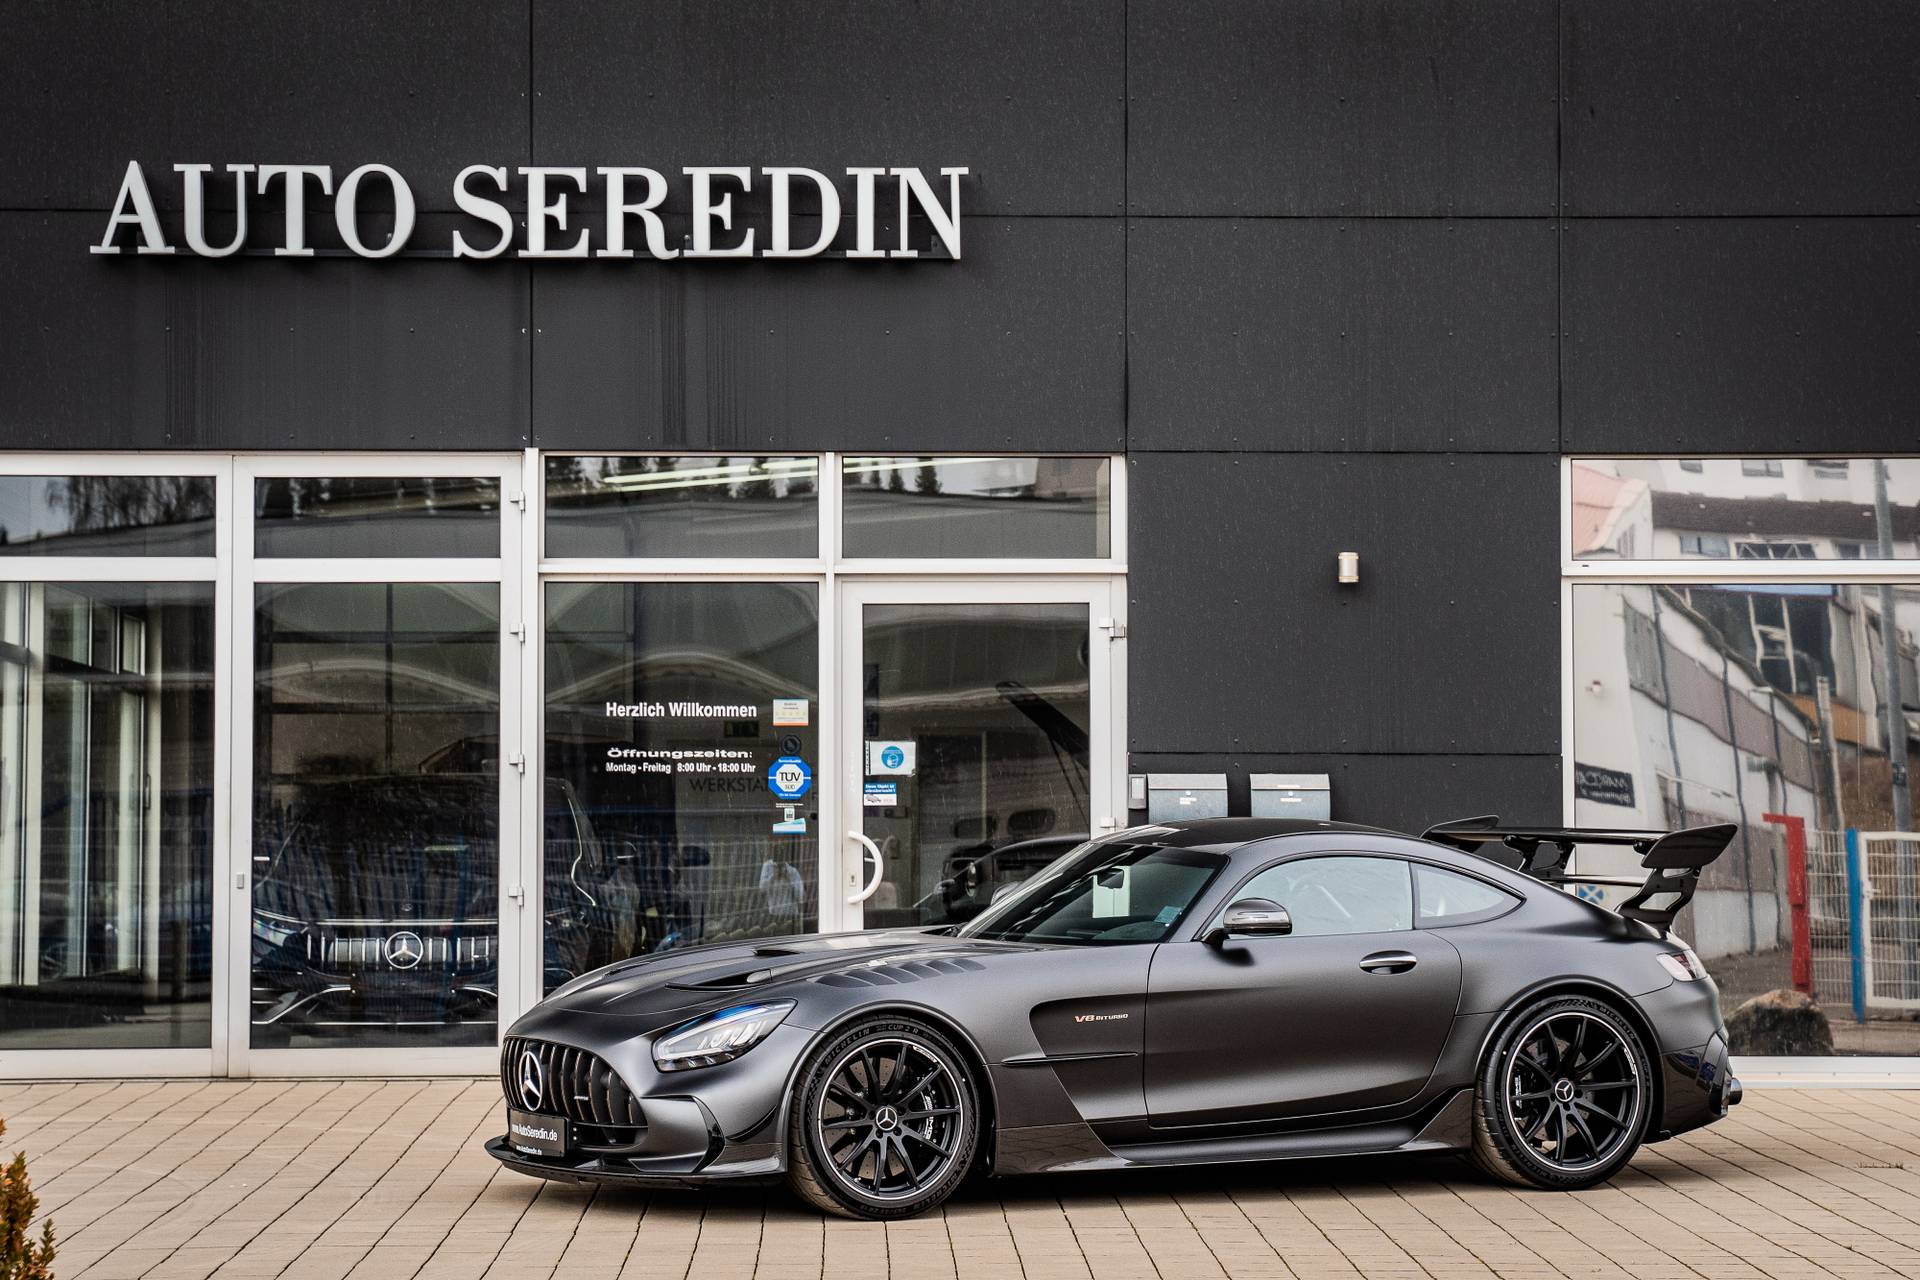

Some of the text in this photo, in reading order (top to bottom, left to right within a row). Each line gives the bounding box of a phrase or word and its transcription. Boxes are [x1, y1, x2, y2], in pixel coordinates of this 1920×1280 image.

[90, 160, 969, 260] AUTO SEREDIN
[605, 702, 758, 717] Herzlich Willkommen
[607, 747, 753, 760] Öffnungszeiten:
[605, 762, 637, 774] Montag
[643, 762, 672, 774] Freitag
[677, 763, 695, 772] 8:00
[696, 763, 711, 772] Uhr
[718, 763, 739, 772] 18:00
[741, 763, 756, 772] Uhr
[780, 771, 801, 781] TÜV
[689, 778, 768, 792] WERKSTA
[825, 1028, 870, 1065] MICHELIN
